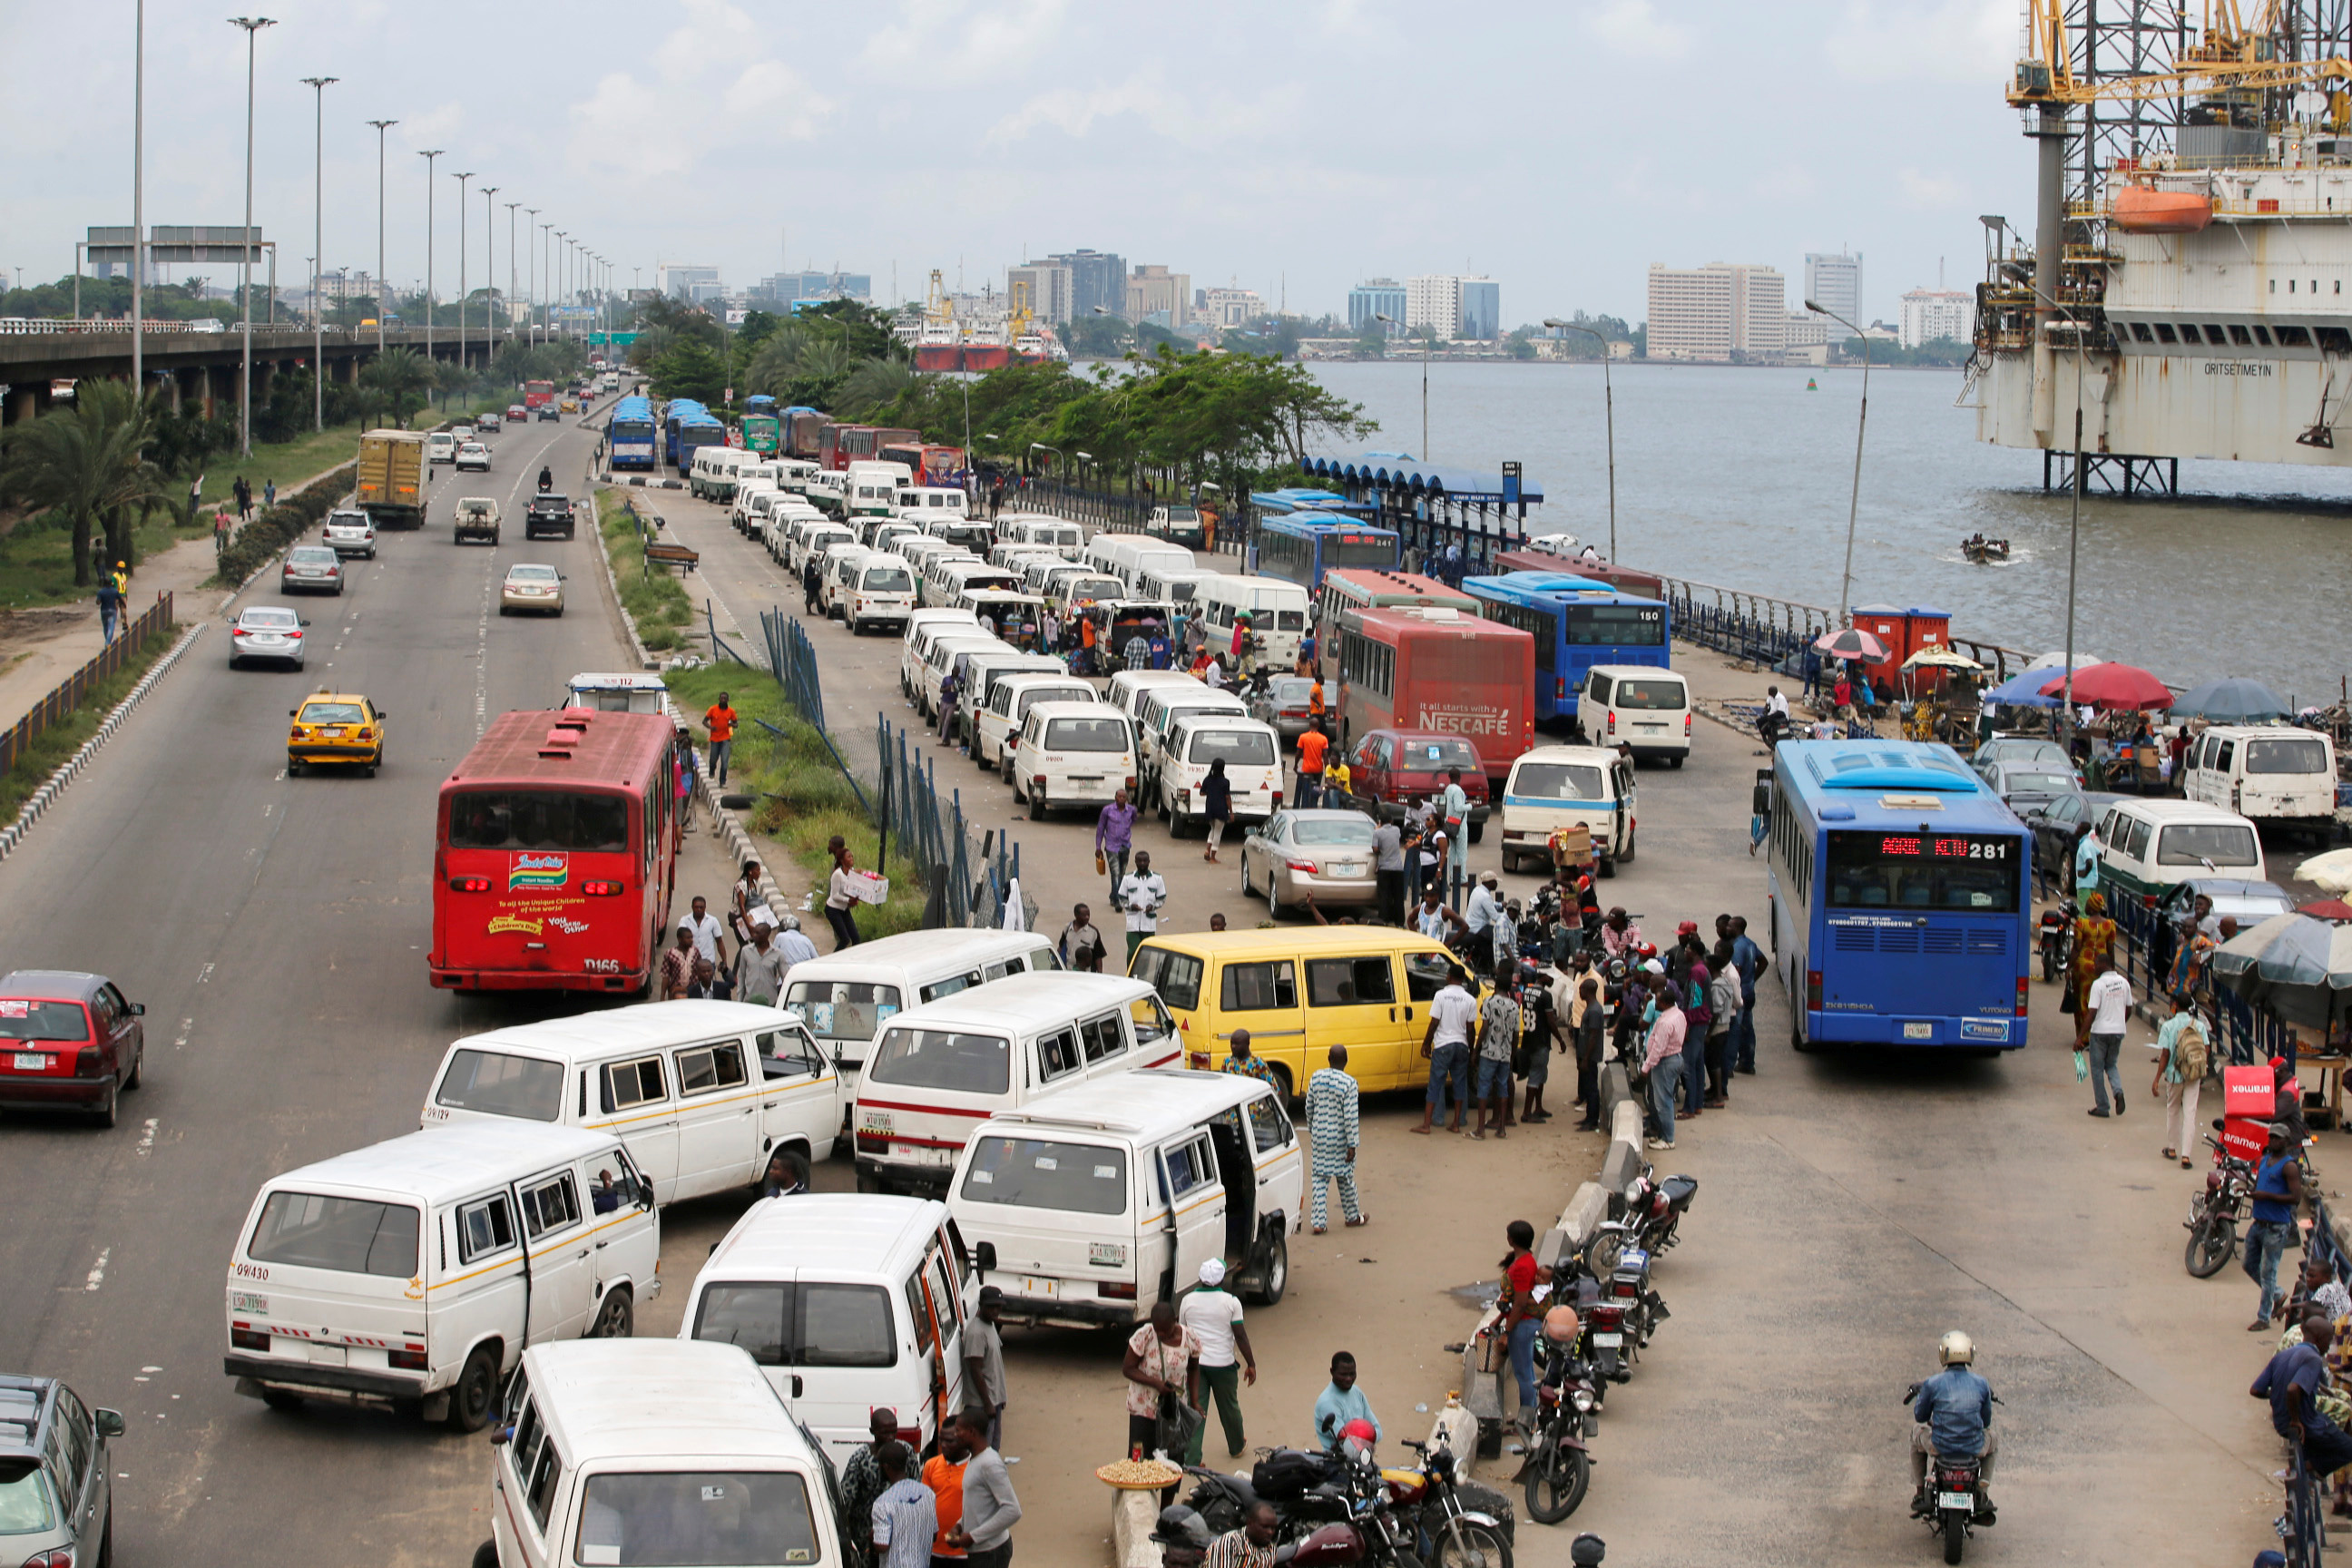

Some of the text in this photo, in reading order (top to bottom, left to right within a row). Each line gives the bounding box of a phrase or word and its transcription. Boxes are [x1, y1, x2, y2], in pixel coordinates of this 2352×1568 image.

[2204, 363, 2271, 377] ORITSETIMEYIN
[1640, 611, 1659, 622] 150
[1428, 702, 1441, 710] all
[1443, 703, 1469, 711] starts
[1471, 704, 1490, 713] with
[1419, 709, 1509, 736] NESCAFÉ
[1882, 838, 1922, 855] AGRIC
[1969, 843, 2005, 859] 281
[531, 899, 555, 908] Unique
[493, 922, 538, 932] Children's Day
[564, 924, 590, 934] Other
[1974, 1025, 2004, 1034] PRIMERO
[2232, 1085, 2270, 1093] aramex
[2223, 1132, 2261, 1152] aramex
[237, 1263, 269, 1280] 09/430
